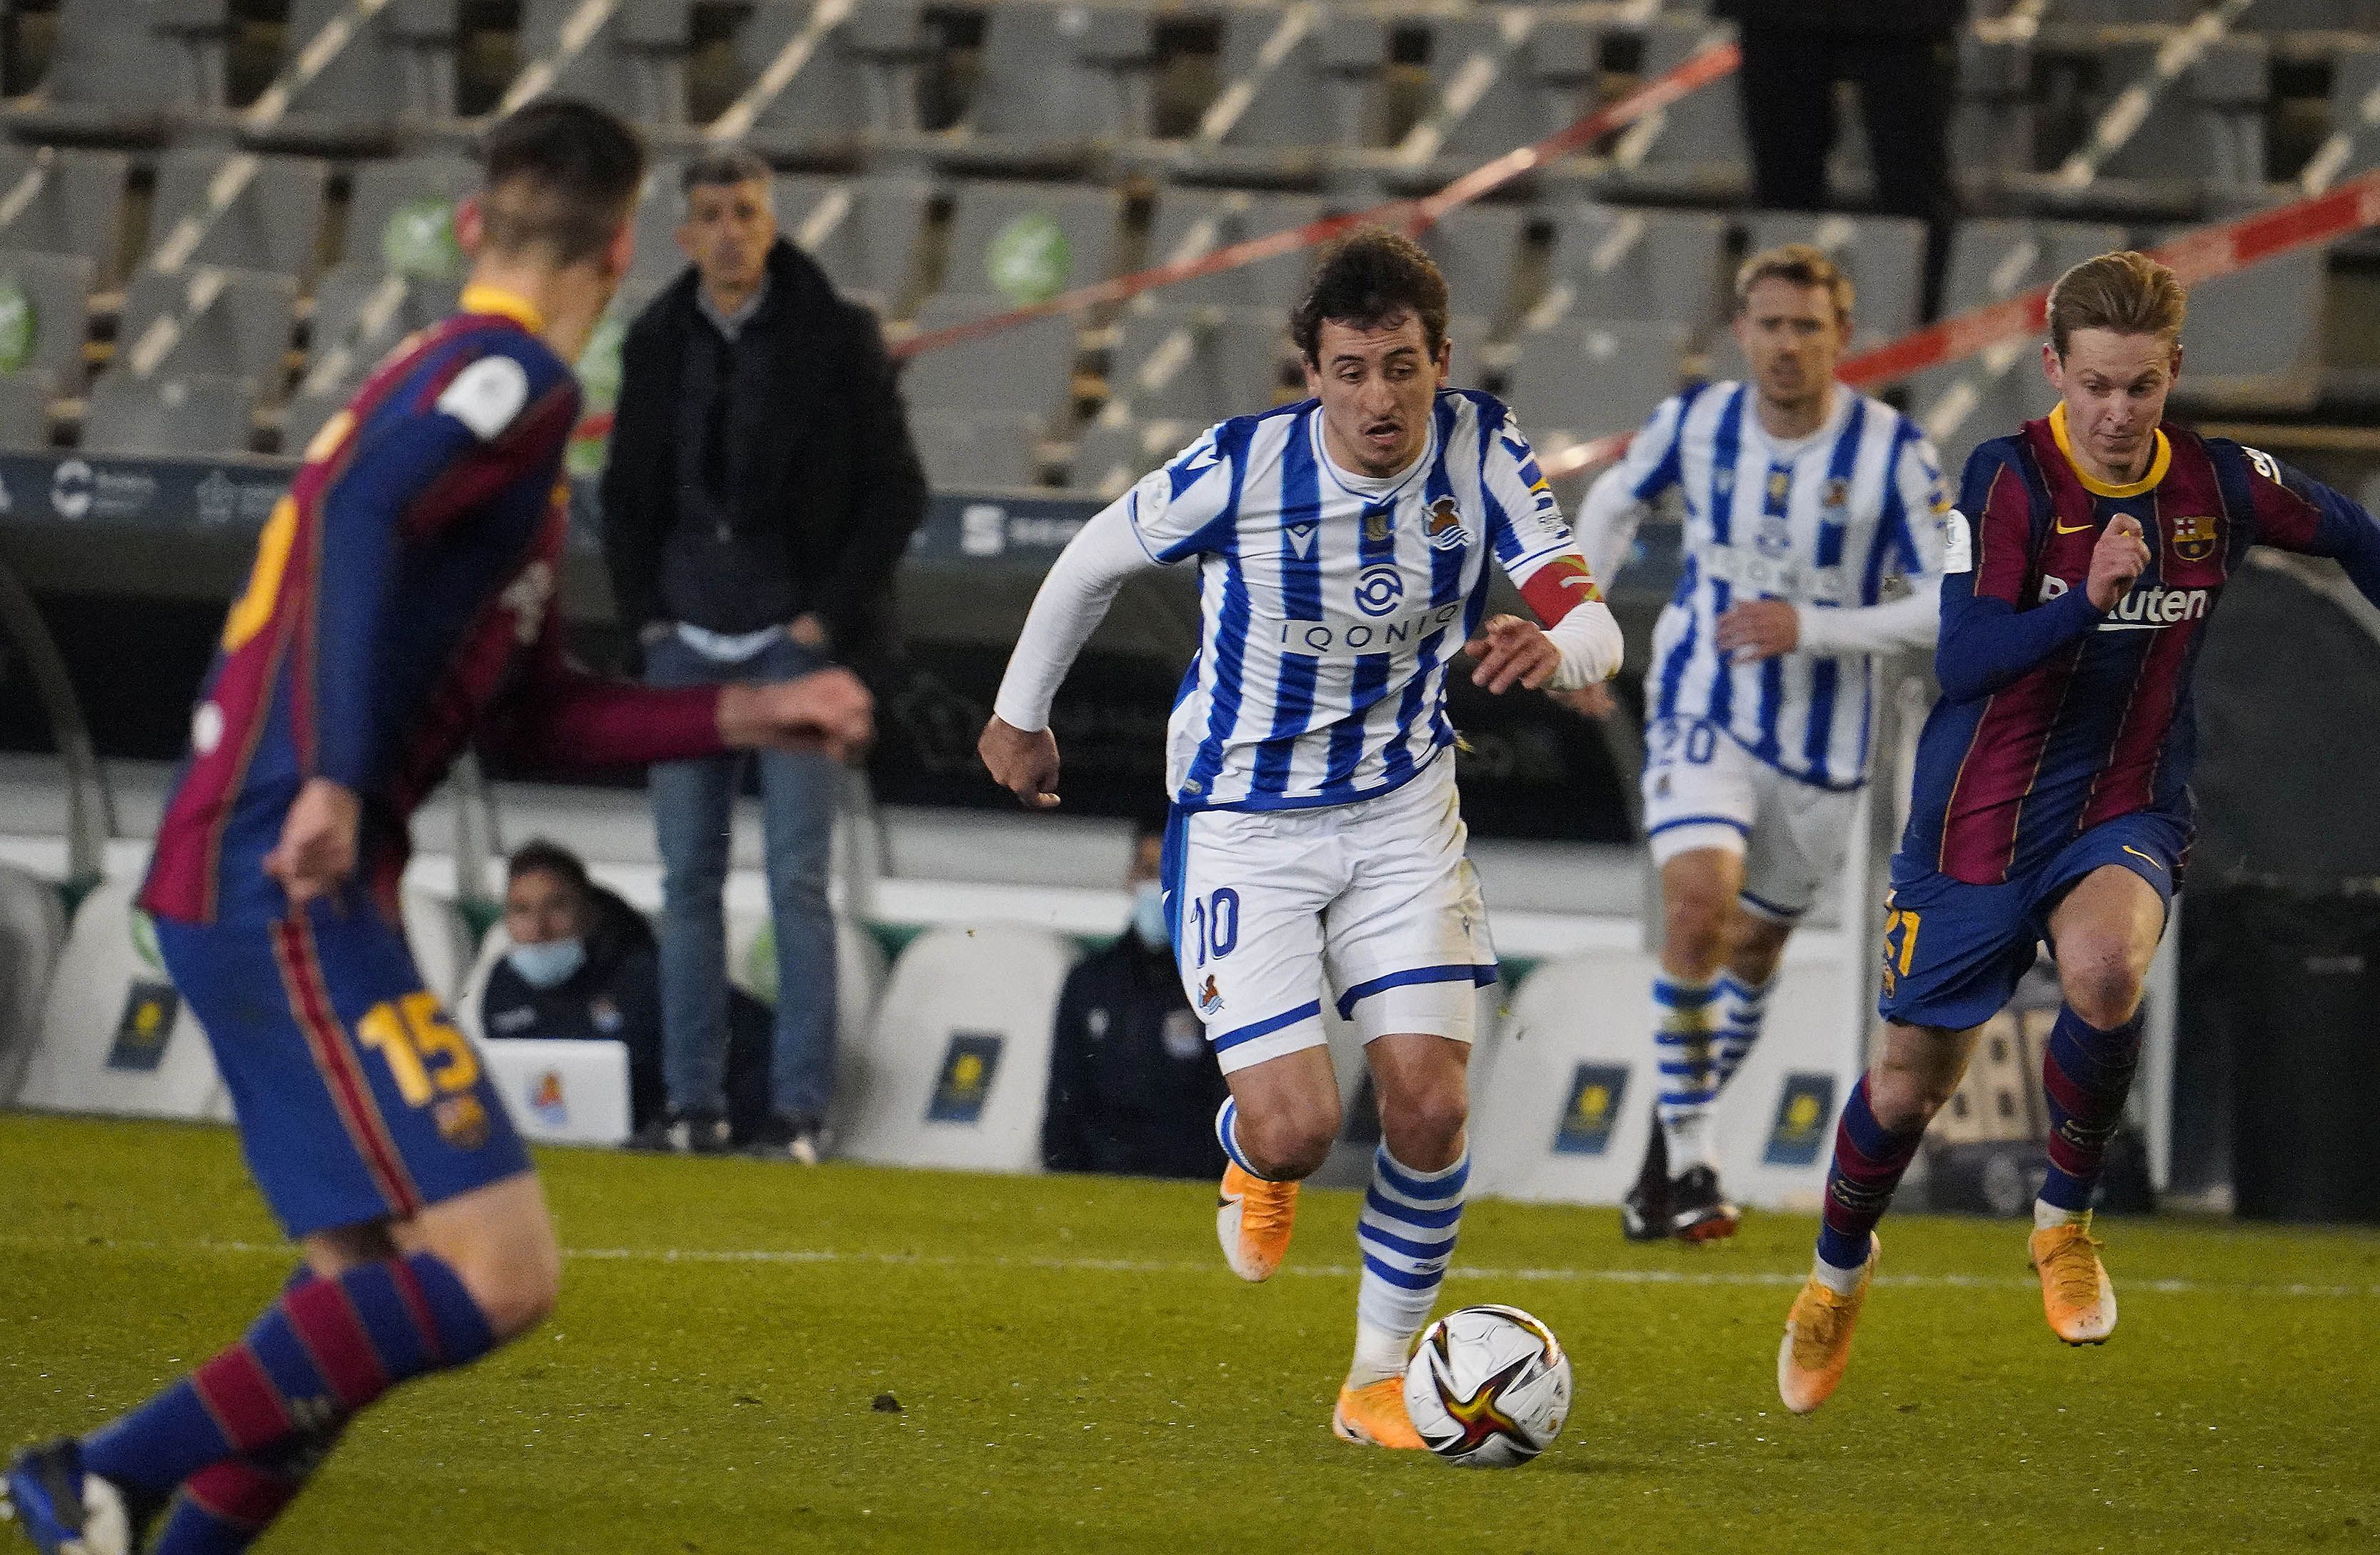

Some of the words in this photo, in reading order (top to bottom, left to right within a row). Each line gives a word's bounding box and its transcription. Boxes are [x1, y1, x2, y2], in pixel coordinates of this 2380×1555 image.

[1281, 604, 1459, 652] IQONIQ
[2038, 574, 2207, 622] Ruten
[1190, 887, 1240, 969] 10
[355, 989, 478, 1107] 15
